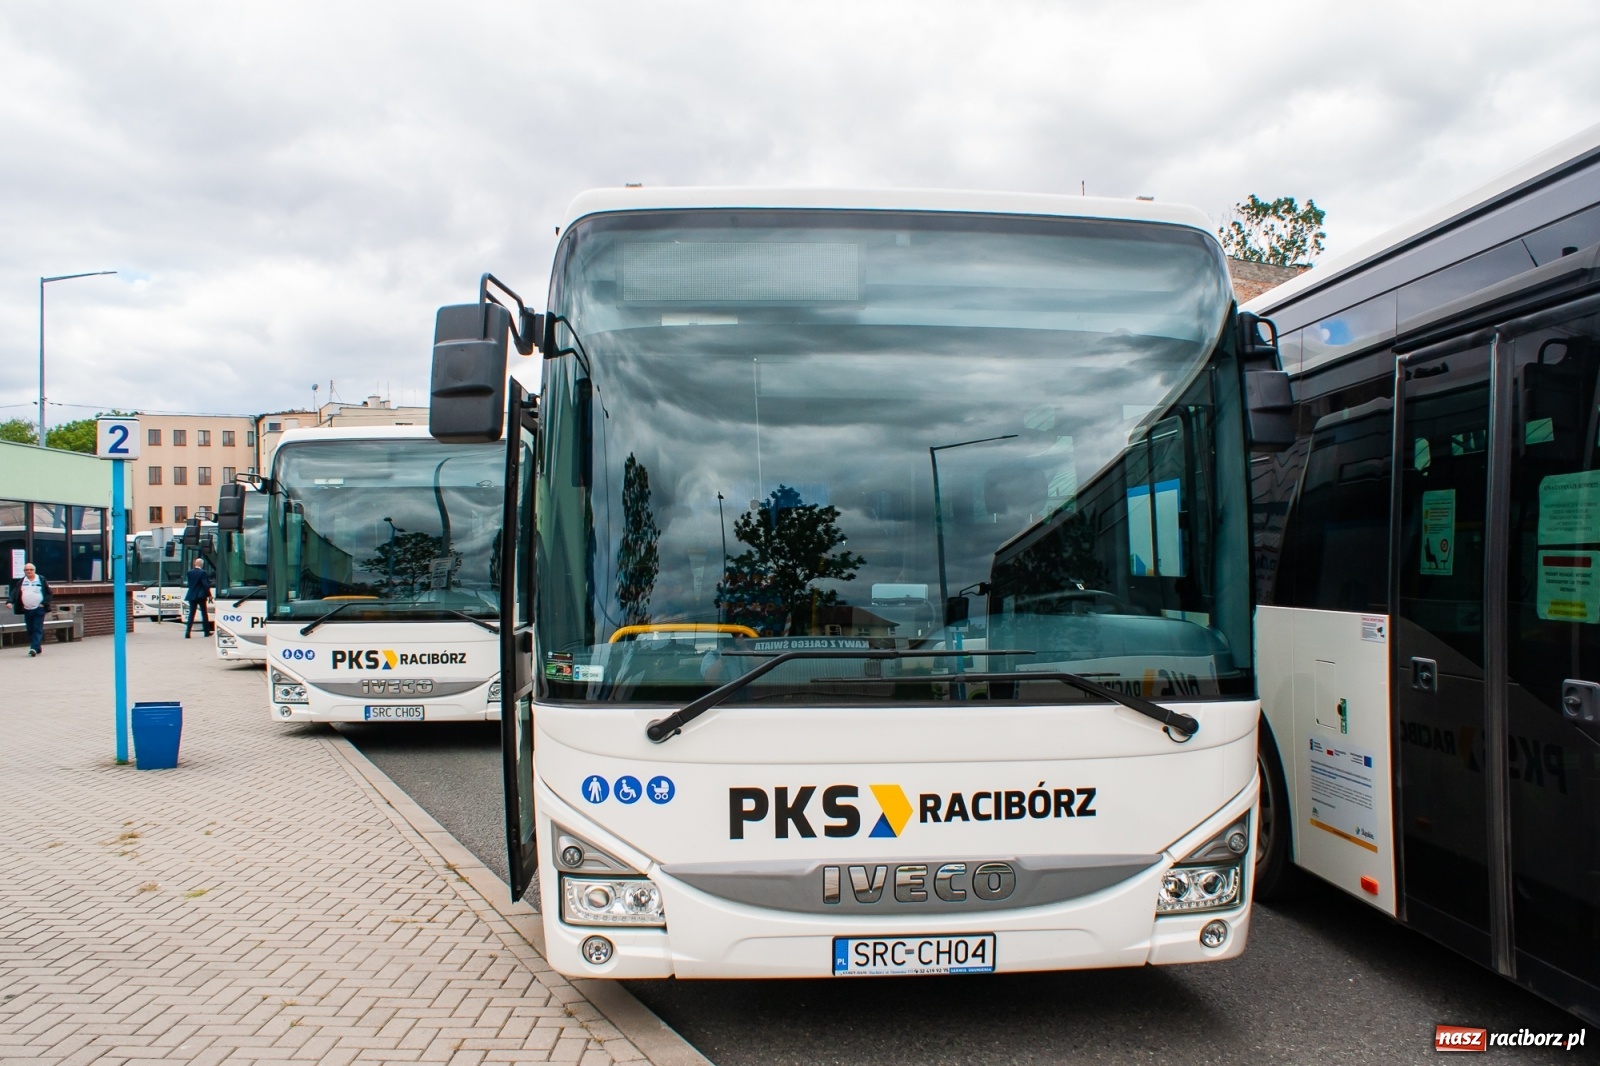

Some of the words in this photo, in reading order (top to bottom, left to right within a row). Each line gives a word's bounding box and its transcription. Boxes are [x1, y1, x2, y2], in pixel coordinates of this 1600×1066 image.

[108, 425, 129, 454] 2
[331, 650, 379, 670] PKS
[399, 649, 467, 665] RACIBÓRZ
[361, 679, 434, 695] IVECO
[372, 707, 392, 718] SRC
[395, 706, 421, 718] CH05
[728, 784, 861, 840] PKS
[918, 781, 1097, 824] RACIBÓRZ
[823, 863, 1017, 904] IVECO
[837, 958, 847, 966] PL
[854, 941, 907, 967] SRC
[918, 939, 986, 965] CH04
